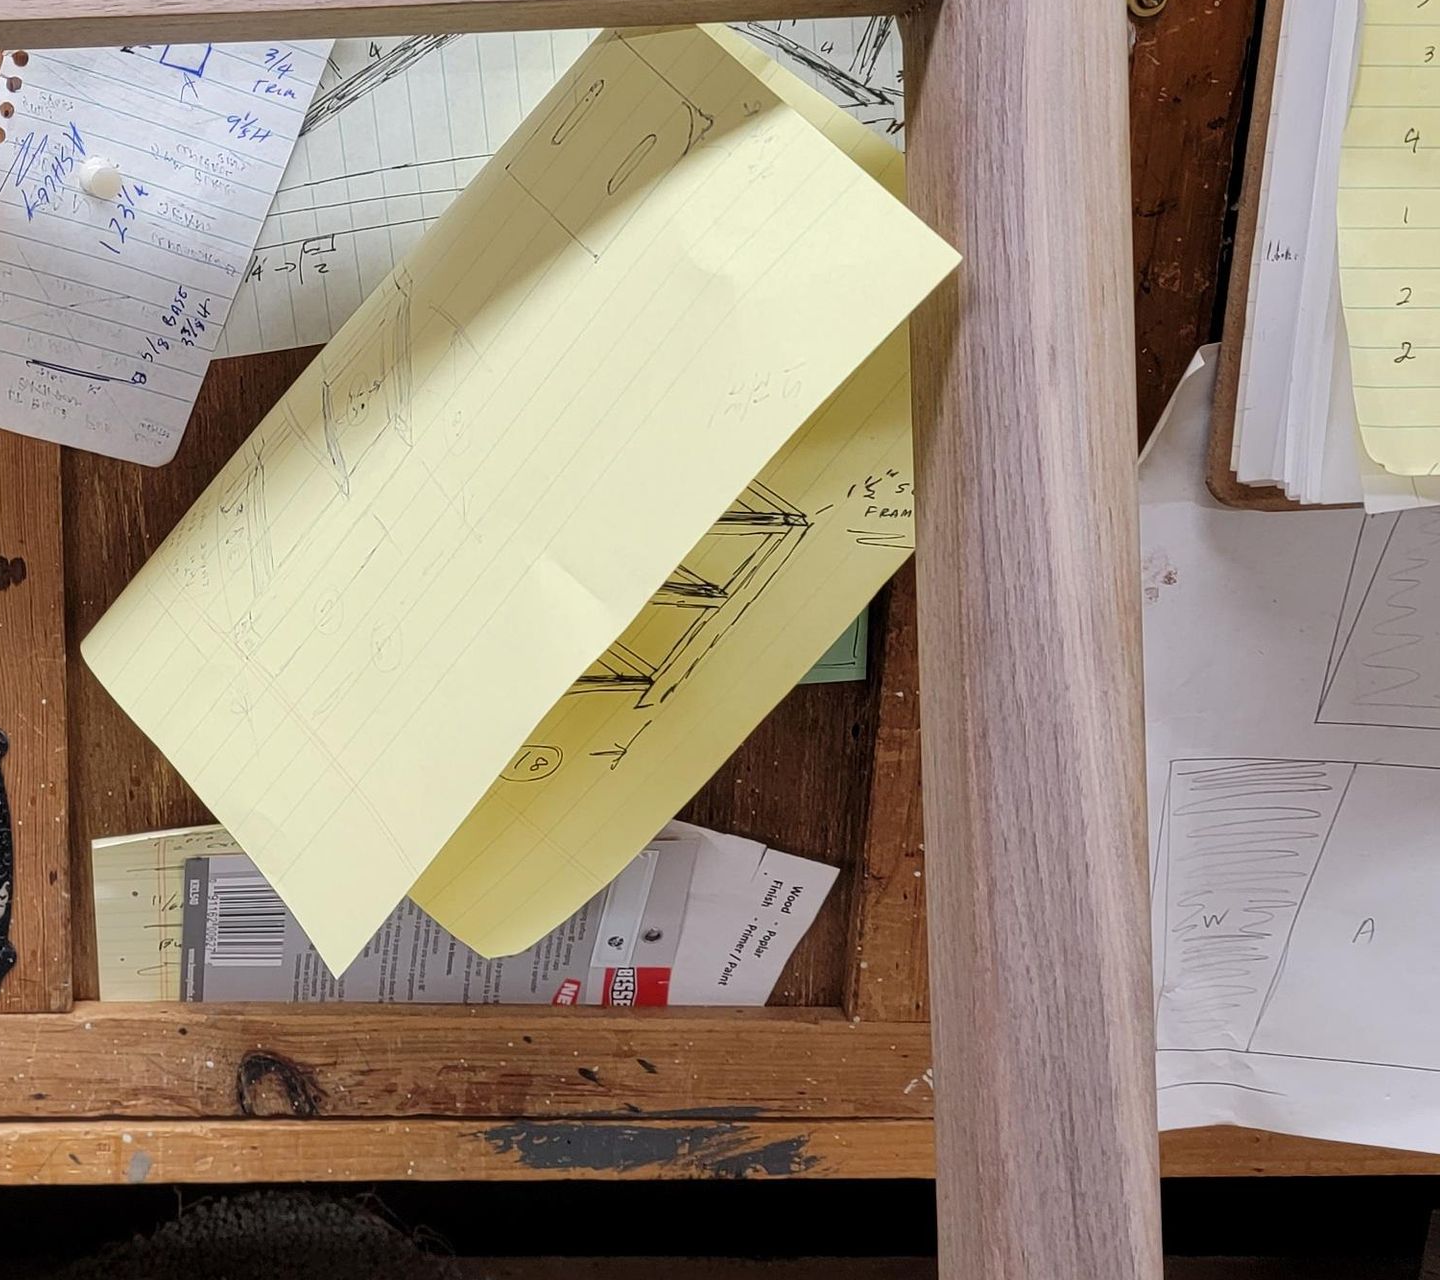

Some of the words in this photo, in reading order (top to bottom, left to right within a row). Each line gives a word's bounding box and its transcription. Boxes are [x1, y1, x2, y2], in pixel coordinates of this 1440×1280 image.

[1396, 287, 1412, 306] 2
[1393, 341, 1416, 365] 2
[760, 879, 784, 908] Finish
[780, 885, 805, 915] Wood
[734, 923, 758, 955] Primer
[753, 929, 777, 959] Poplar
[1352, 917, 1375, 944] A
[612, 968, 635, 1007] BESSE
[718, 961, 738, 987] Paint
